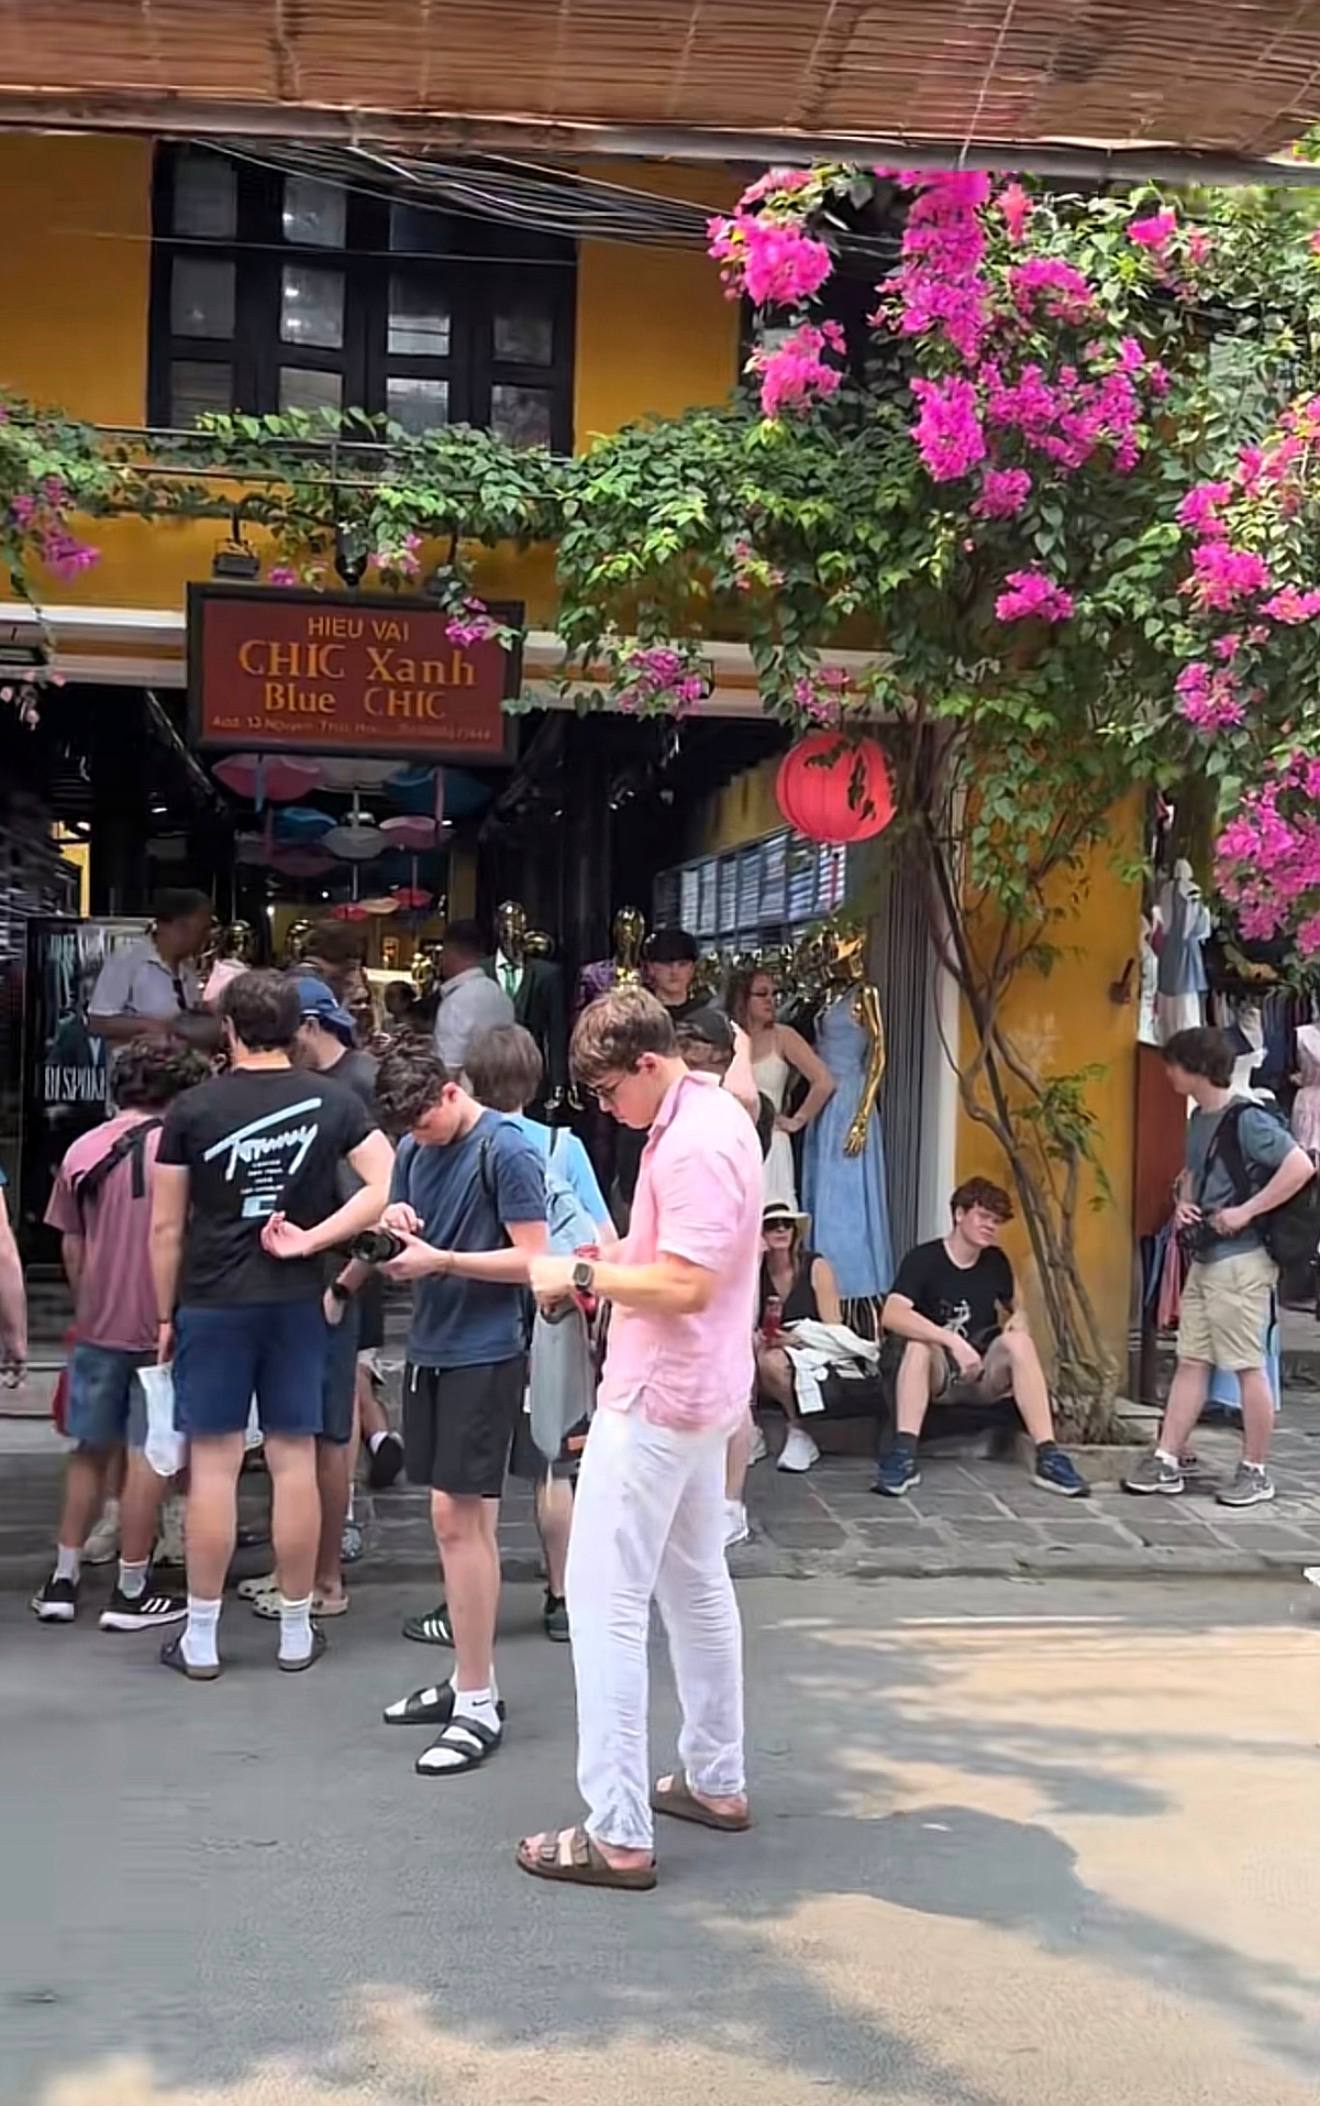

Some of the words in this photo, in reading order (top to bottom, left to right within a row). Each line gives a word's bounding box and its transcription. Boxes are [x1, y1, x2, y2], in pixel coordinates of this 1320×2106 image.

[238, 639, 346, 680] CHIC
[365, 646, 477, 686] Xanh
[264, 682, 337, 714] Blue
[364, 687, 447, 719] CHIC
[203, 1097, 323, 1181] Tommy
